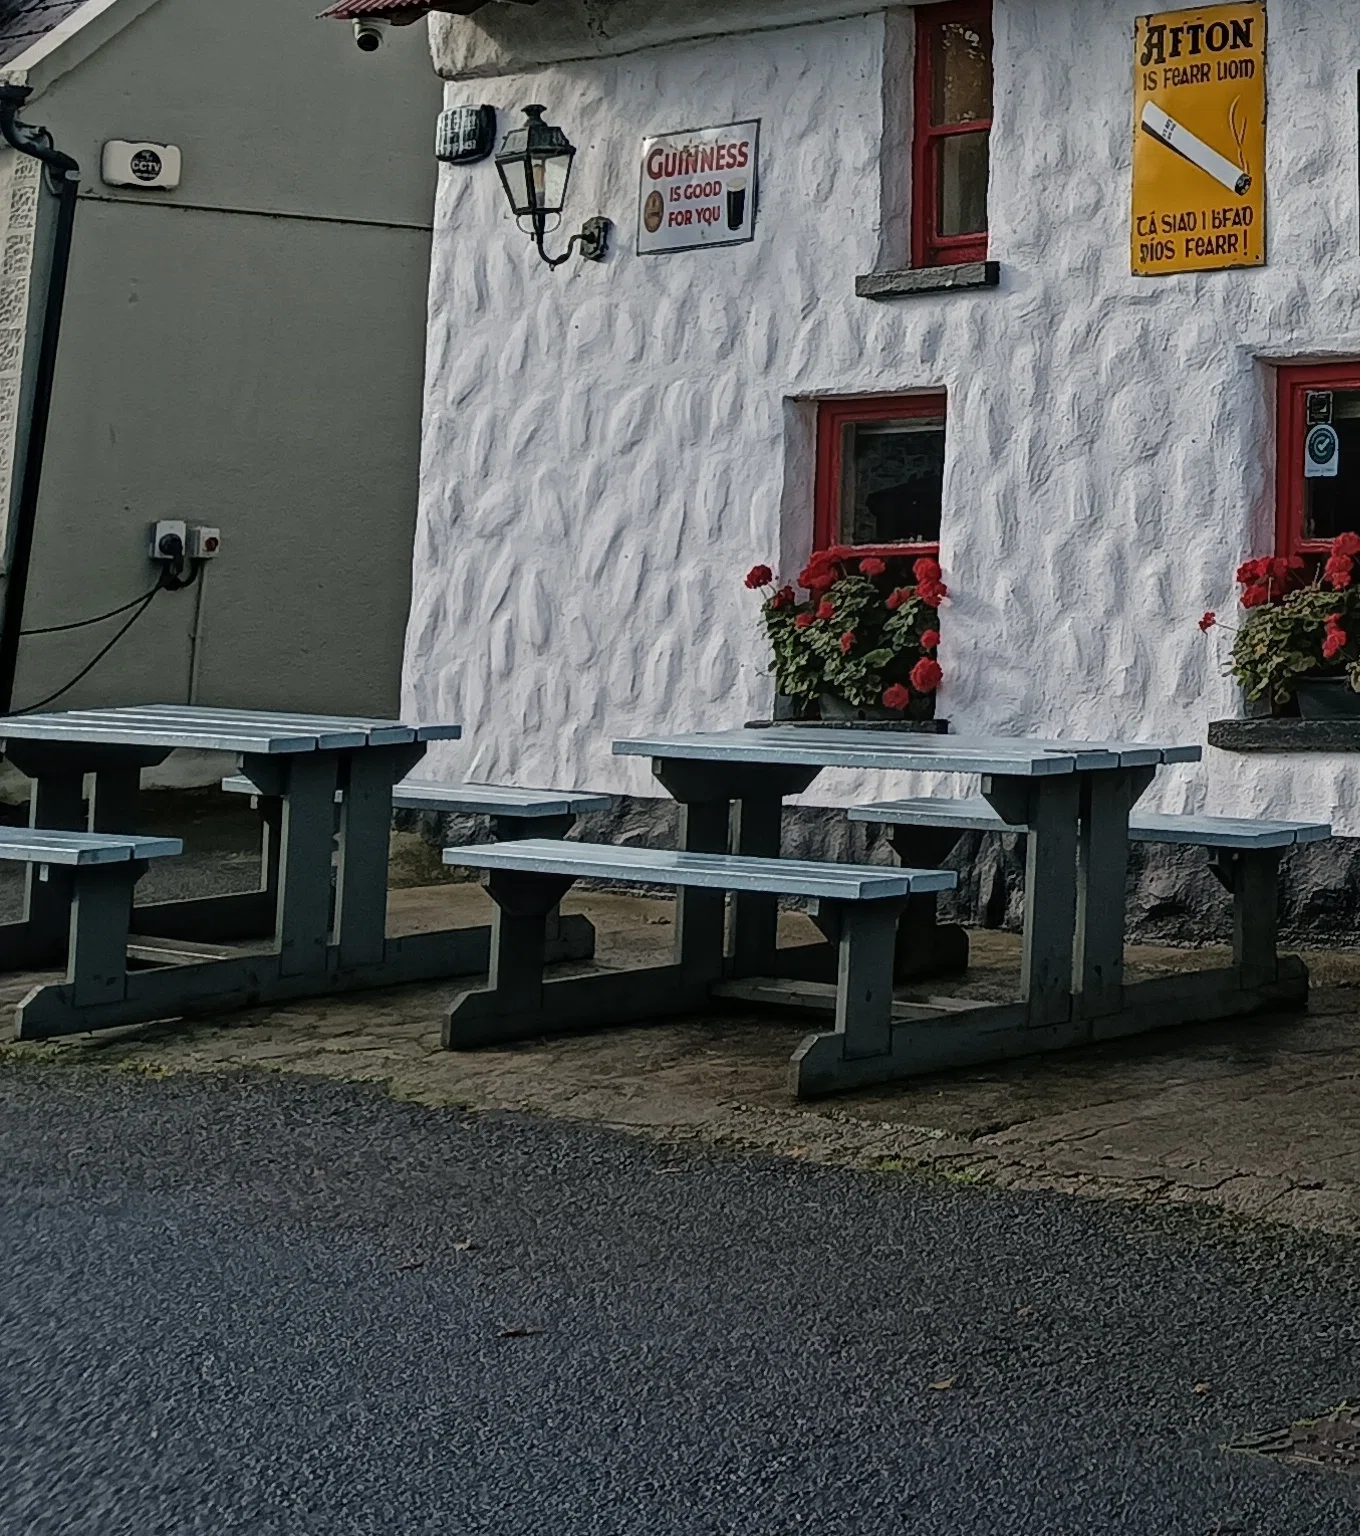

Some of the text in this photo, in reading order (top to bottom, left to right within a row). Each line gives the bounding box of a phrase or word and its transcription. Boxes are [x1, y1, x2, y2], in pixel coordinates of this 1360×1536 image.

[1140, 17, 1255, 66] AFTON
[131, 160, 160, 172] CCTV
[647, 141, 749, 180] GUINNESS
[670, 181, 722, 202] IS GOOD
[668, 205, 720, 227] FOR YOU
